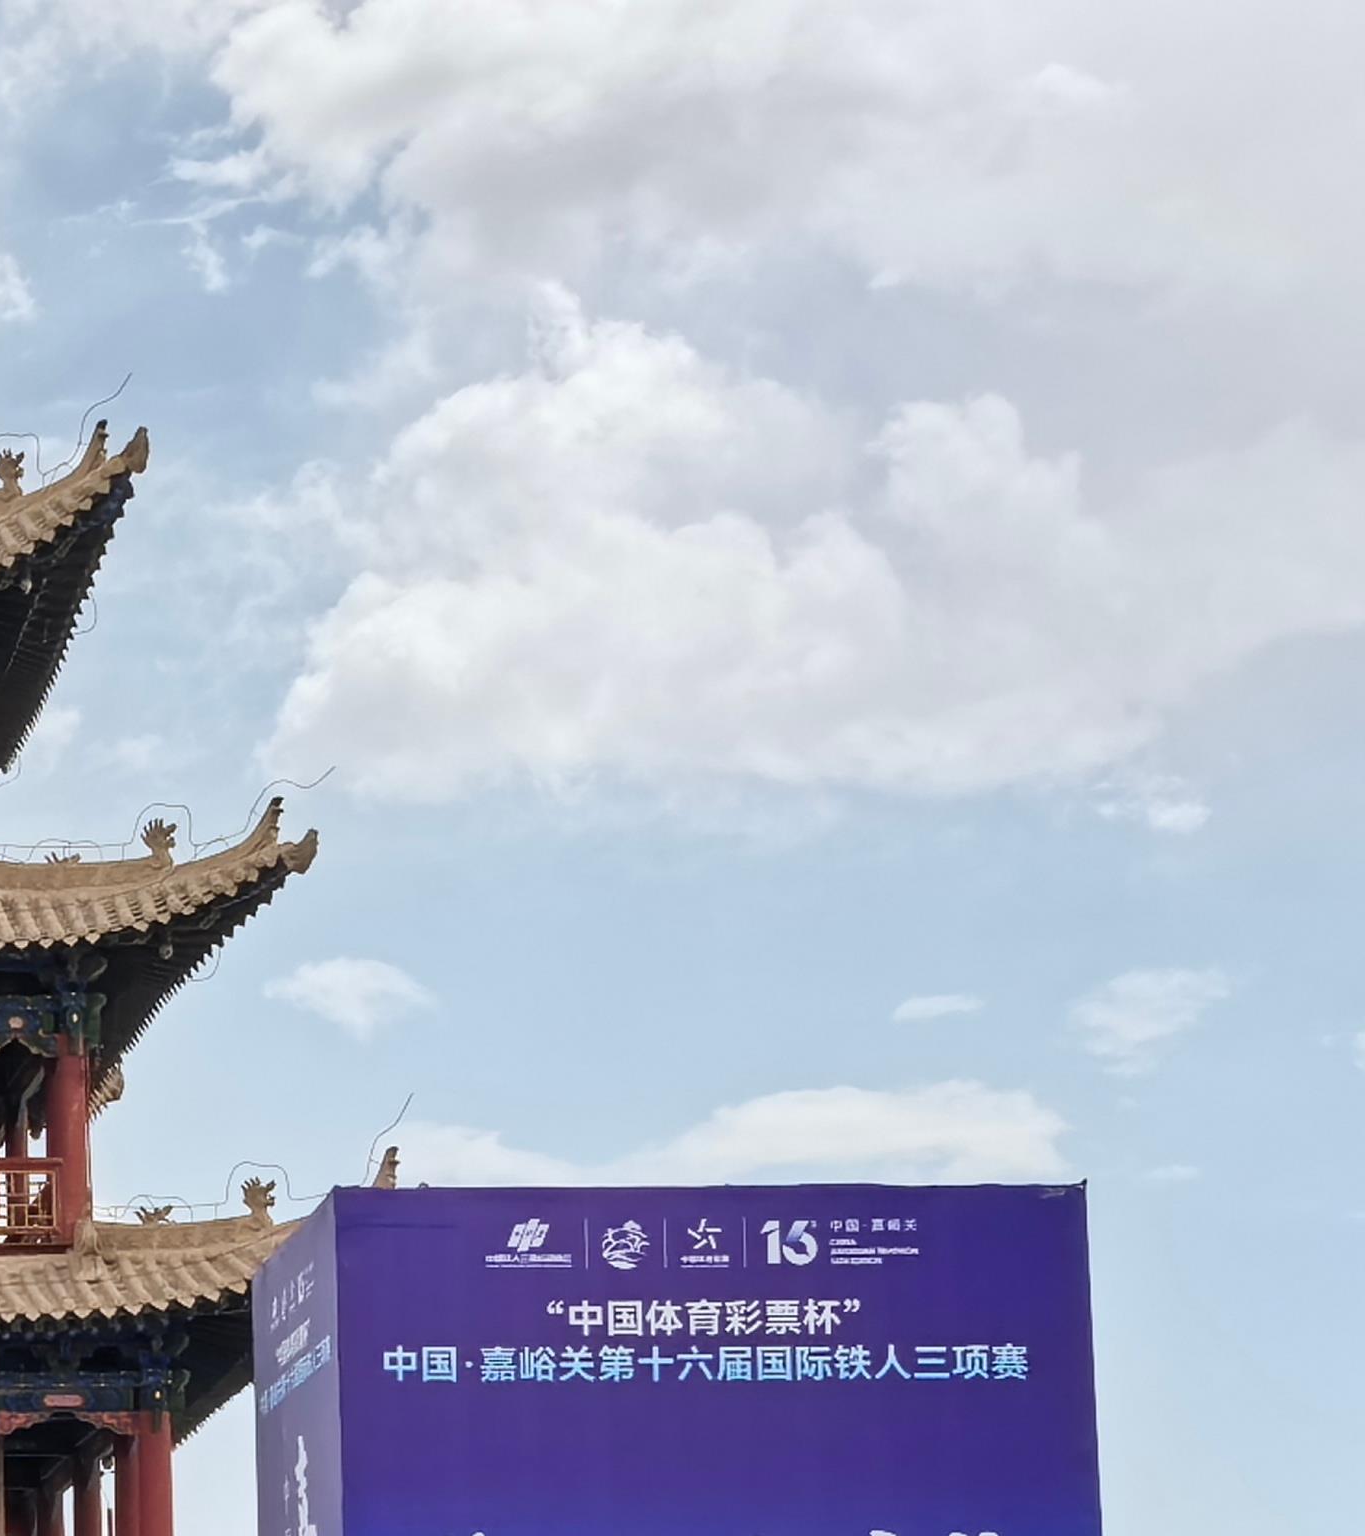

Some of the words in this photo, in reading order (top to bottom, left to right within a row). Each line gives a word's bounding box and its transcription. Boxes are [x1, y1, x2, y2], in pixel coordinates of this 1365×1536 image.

[546, 1298, 861, 1337] “中国体育彩票杯”
[382, 1343, 1029, 1383] 中国·嘉峪关第十六届国际铁人三项赛
